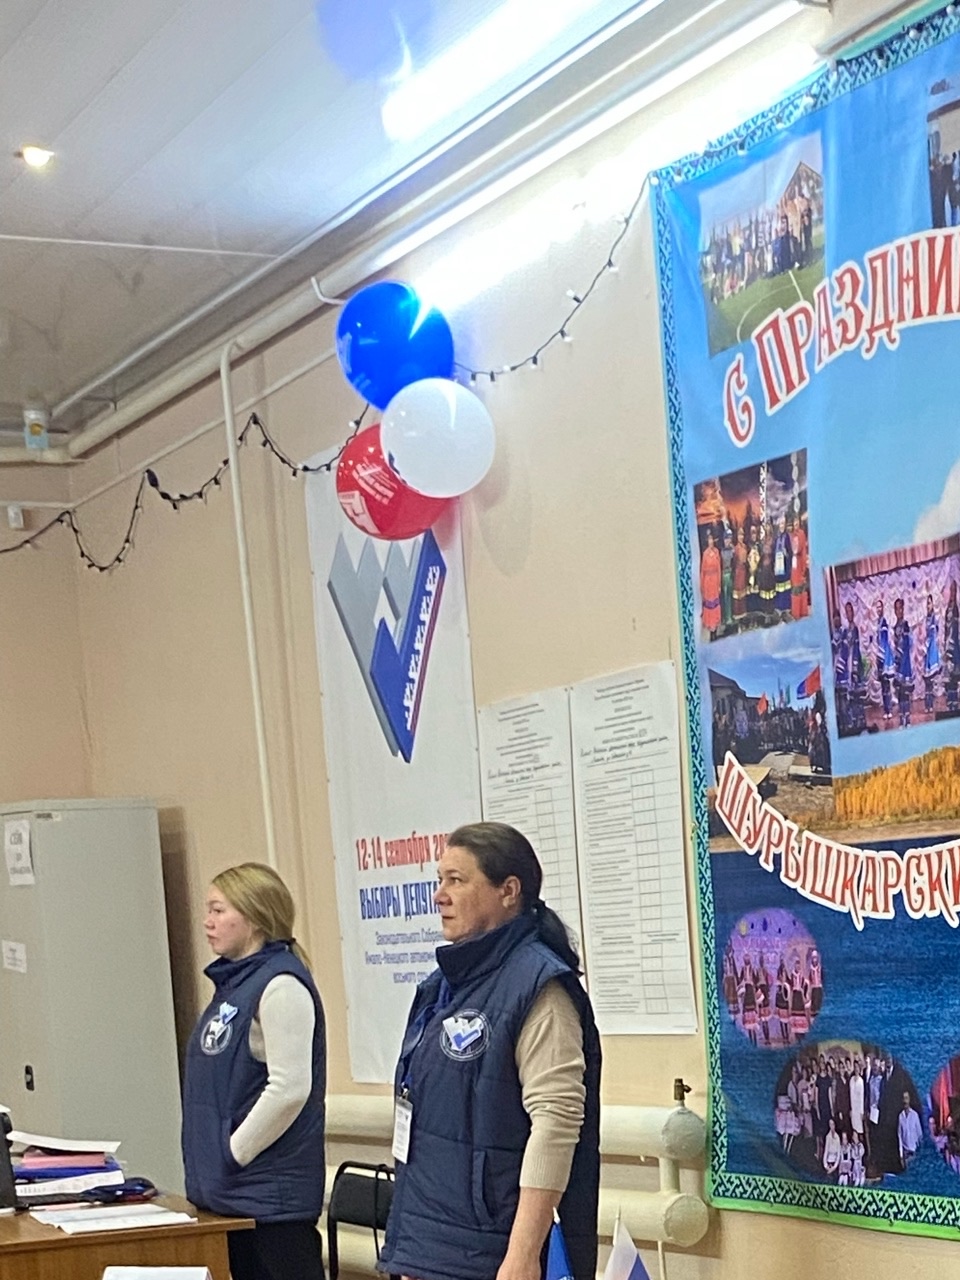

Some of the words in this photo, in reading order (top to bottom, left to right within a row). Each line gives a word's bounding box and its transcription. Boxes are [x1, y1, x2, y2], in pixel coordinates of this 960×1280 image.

[725, 356, 753, 445] С
[385, 830, 431, 872] сентября
[433, 833, 450, 862] 20
[359, 884, 401, 920] ВЫБОРЫ
